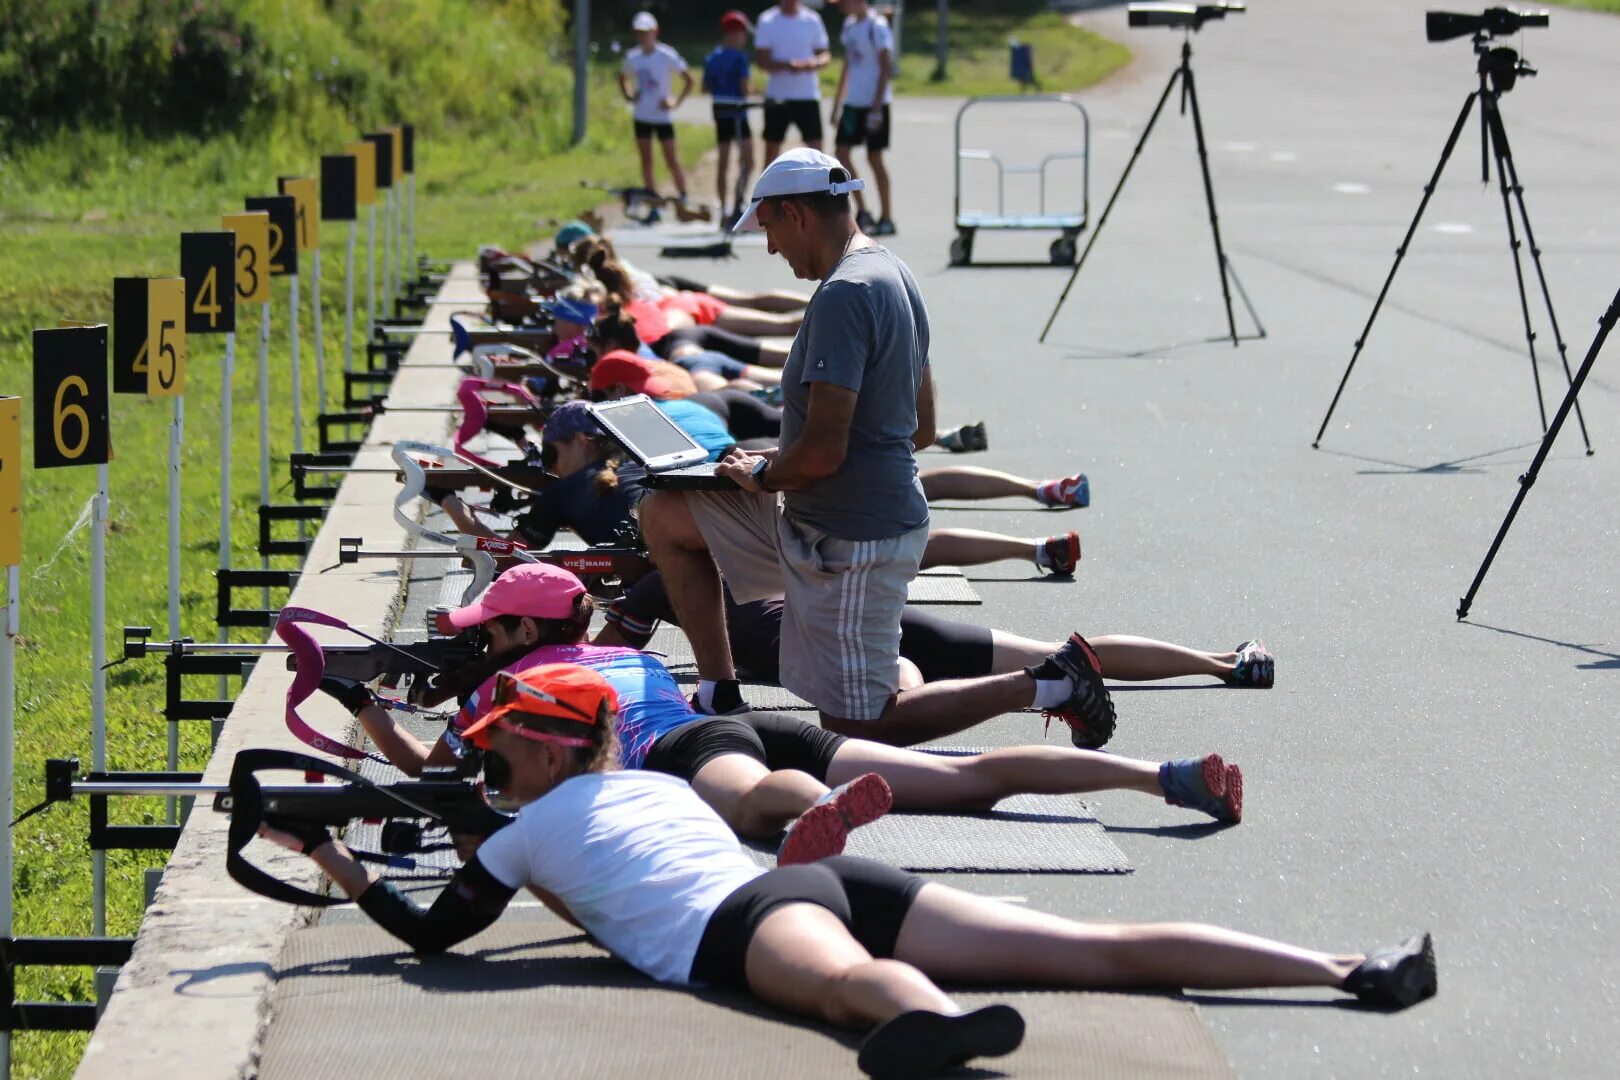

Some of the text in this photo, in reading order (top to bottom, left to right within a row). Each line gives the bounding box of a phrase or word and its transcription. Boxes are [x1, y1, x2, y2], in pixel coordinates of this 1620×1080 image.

[297, 200, 308, 249] 1
[193, 266, 223, 328] 4
[236, 244, 259, 299] 3
[158, 320, 177, 390] 5
[53, 375, 91, 460] 6
